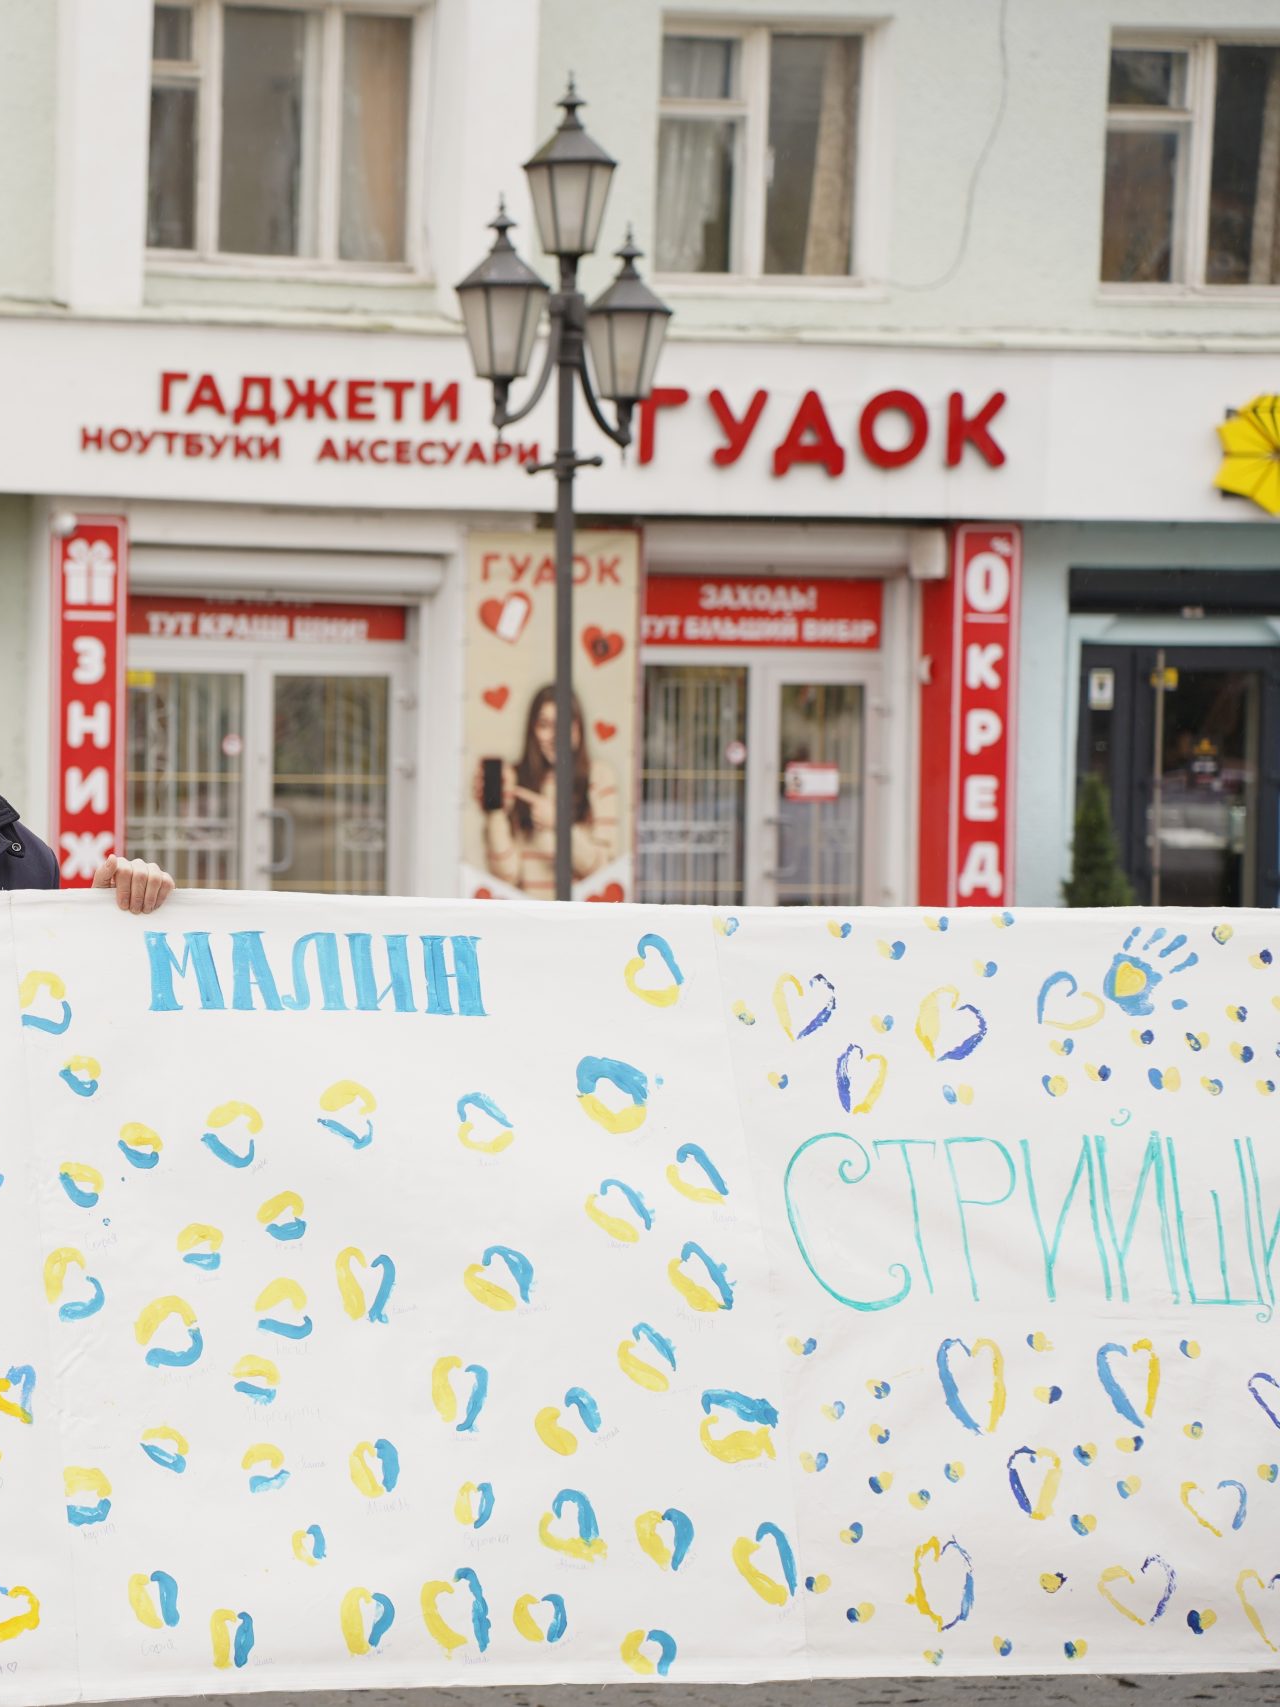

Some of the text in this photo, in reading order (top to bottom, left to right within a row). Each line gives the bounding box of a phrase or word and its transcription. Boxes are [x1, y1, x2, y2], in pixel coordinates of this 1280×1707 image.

[160, 371, 461, 426] ГАДЖЕТИ
[638, 387, 1008, 478] ГУДОК
[81, 426, 540, 466] НОУТБУКИ АКСЕСУАРИ
[147, 611, 195, 636] ТУТ
[959, 643, 1004, 898] КРЕД
[144, 930, 491, 1016] МАЛИН
